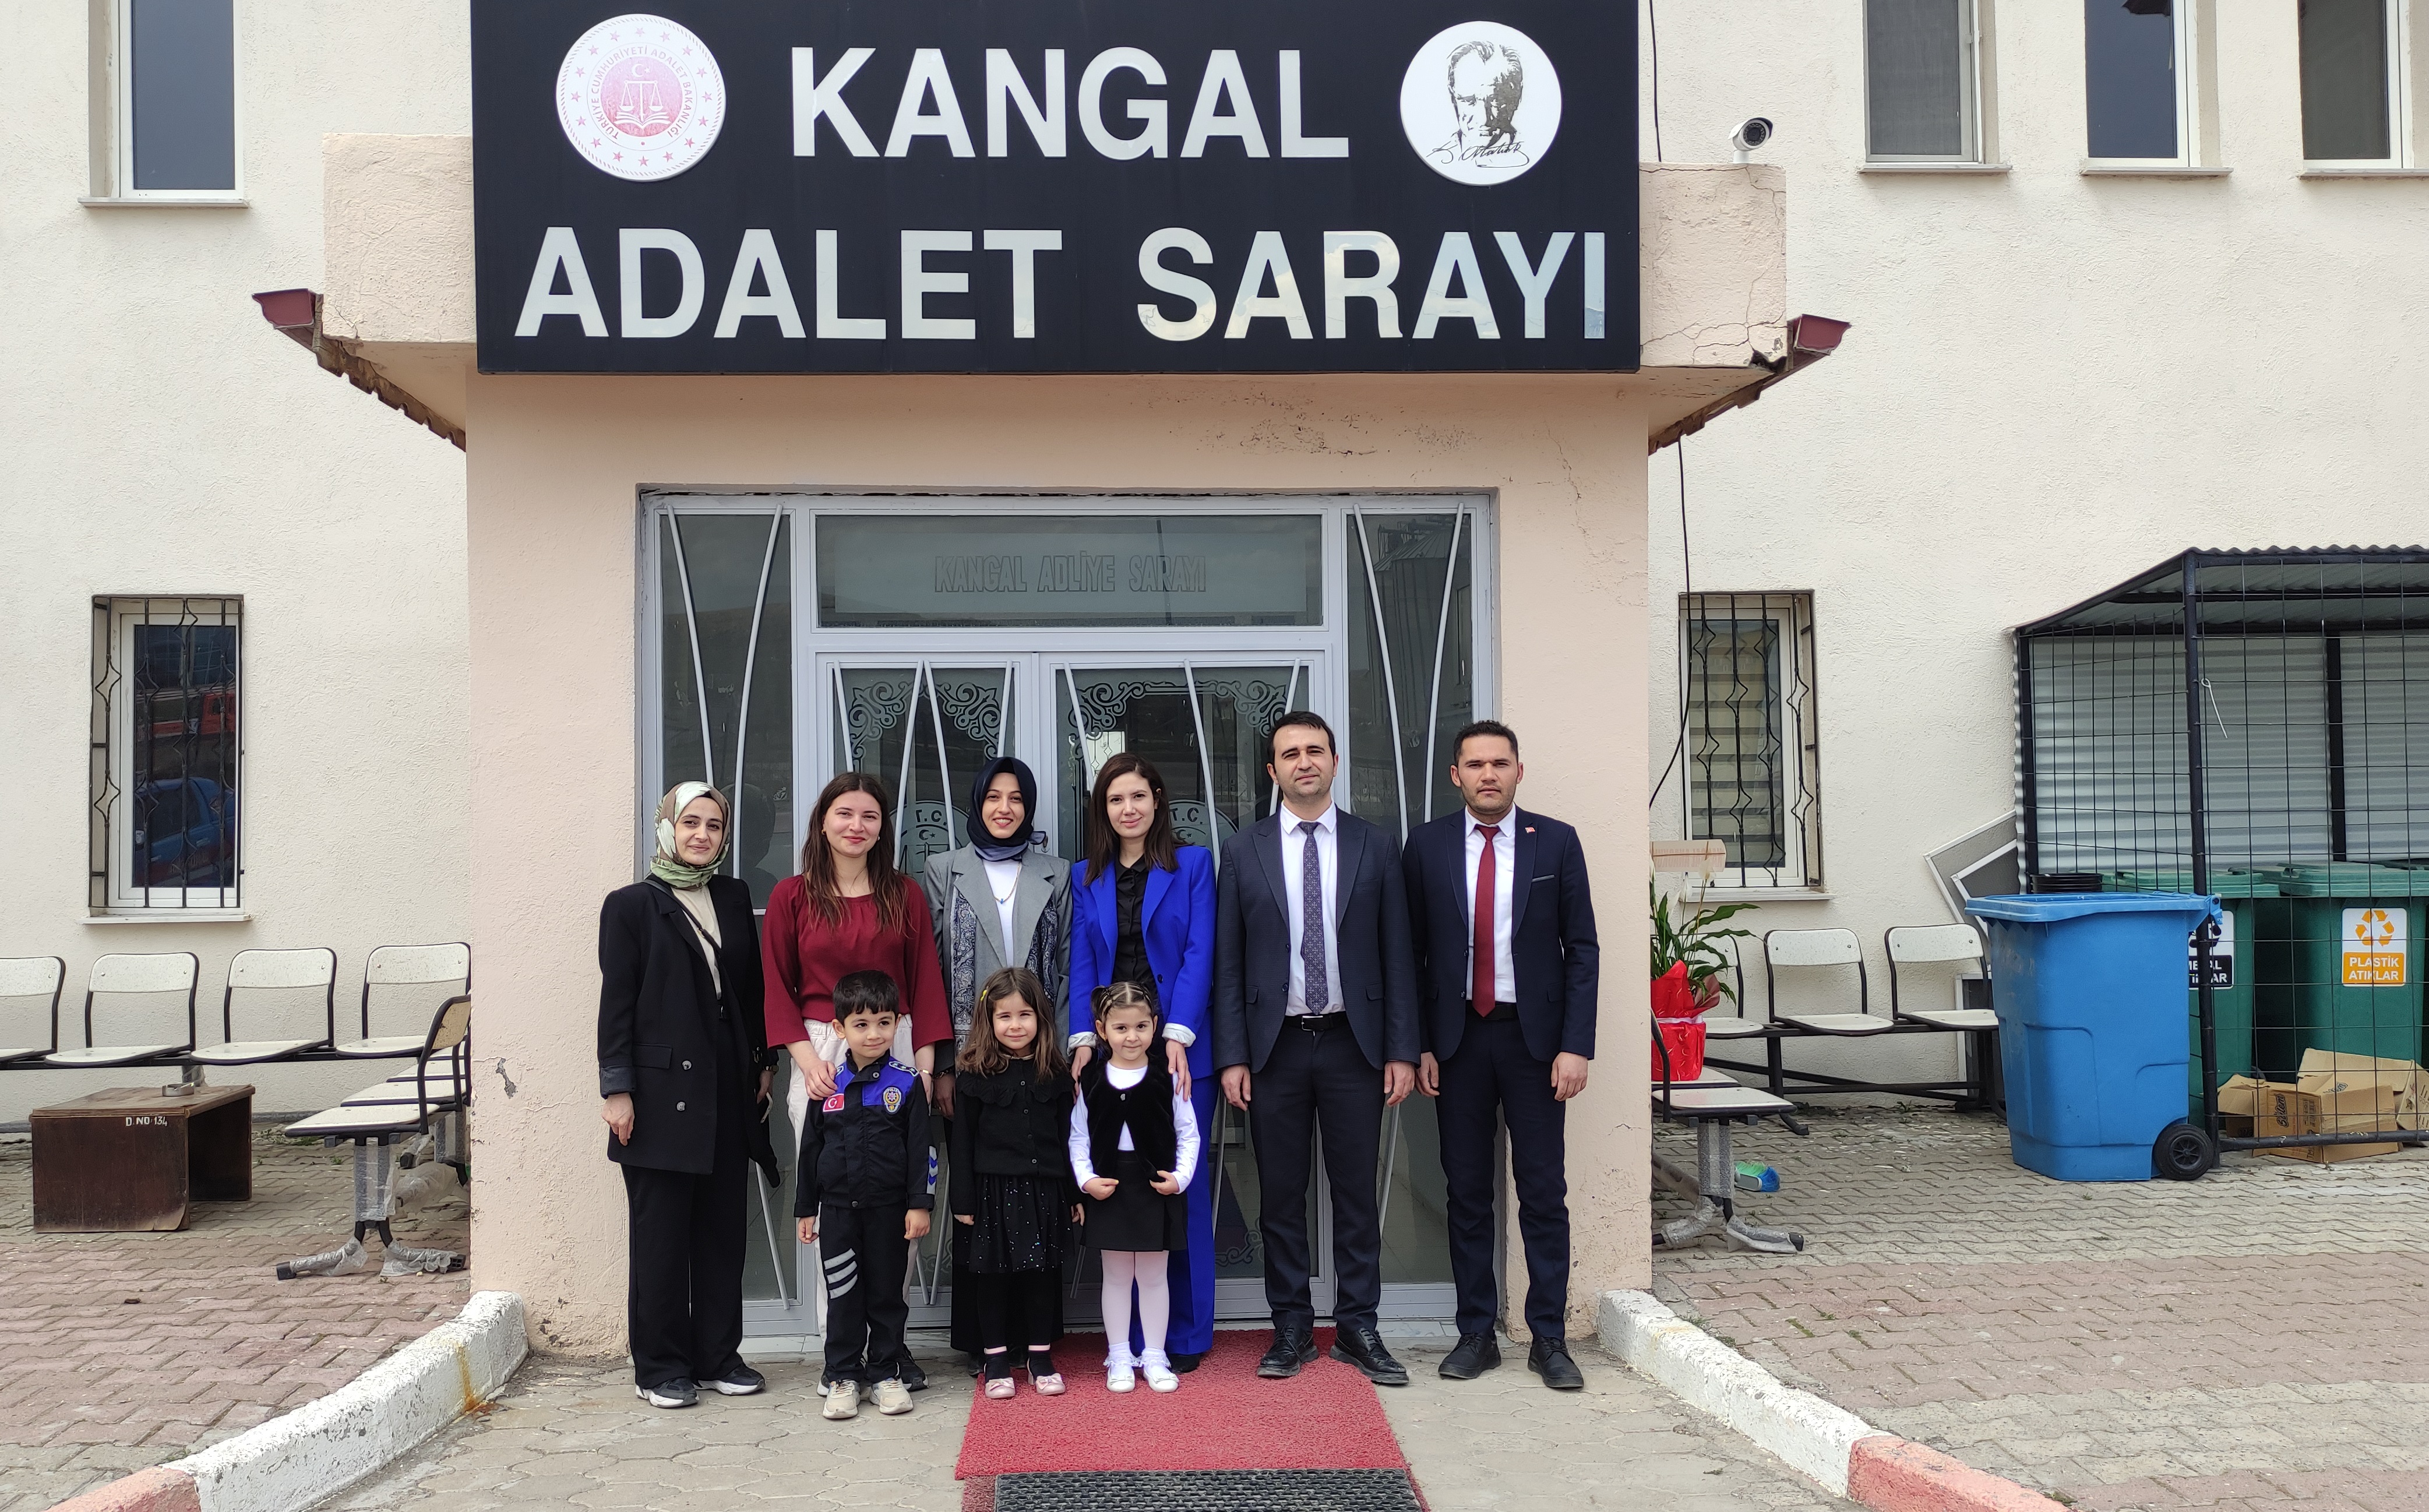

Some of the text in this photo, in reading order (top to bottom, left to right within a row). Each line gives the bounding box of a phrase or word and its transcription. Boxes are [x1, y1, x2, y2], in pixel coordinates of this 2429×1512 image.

[591, 45, 693, 139] TÜRKİYE CUMHURİYETİ ADALET BAKANLIĞI
[792, 47, 1348, 159] KANGAL
[516, 227, 1604, 341] ADALET SARAYI
[935, 550, 1206, 592] KANGAL ADLİYE SARAYI
[1169, 808, 1203, 824] T.C.
[2349, 970, 2399, 981] ATIKLAR
[2350, 955, 2399, 967] PLASTİK
[154, 1116, 167, 1127] 134
